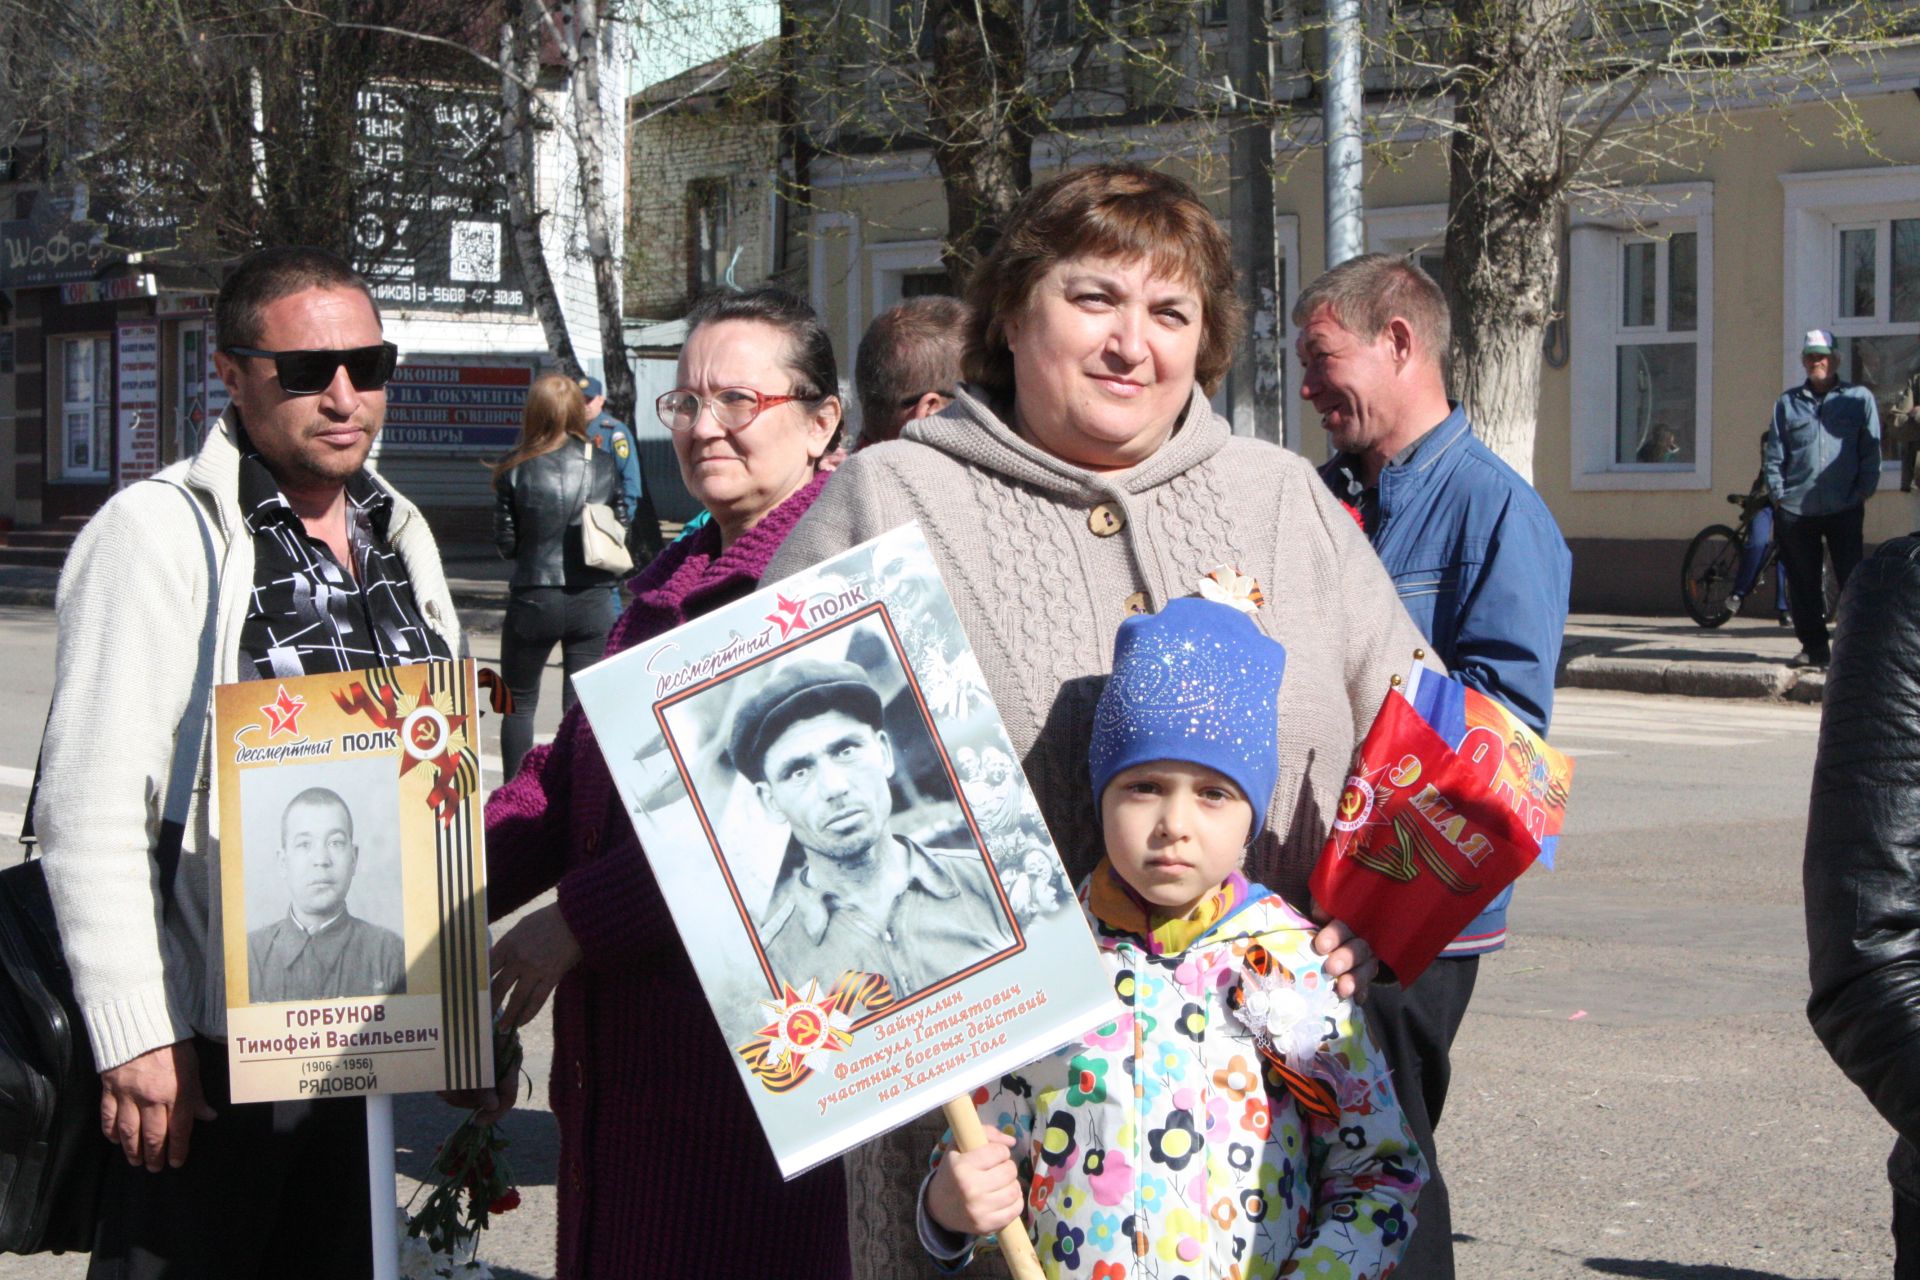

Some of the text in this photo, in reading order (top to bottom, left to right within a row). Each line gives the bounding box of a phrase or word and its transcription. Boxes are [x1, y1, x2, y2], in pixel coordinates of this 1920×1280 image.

[393, 367, 460, 382] ОКОПИЯ
[401, 388, 422, 402] НА
[428, 389, 528, 404] ДОКУМЕНТЫ
[386, 408, 448, 421] ОВЛЕНИЕ
[384, 428, 464, 443] ЦТОВАРЫ
[808, 586, 867, 623] ПОЛК
[342, 730, 397, 752] ПОЛК
[1389, 754, 1422, 787] 9
[1408, 783, 1494, 868] МАЯ
[285, 1004, 386, 1028] ГОРБУНОВ
[873, 990, 964, 1041] Зайнуллин
[236, 1027, 439, 1056] Тимофей Васильевич
[833, 983, 1023, 1081] Фаткулл Гатиятович
[817, 989, 1048, 1116] участник боевых действий
[301, 1059, 332, 1075] (1906
[342, 1057, 373, 1073] 1956)
[878, 1032, 1008, 1103] на Халхин-Голе
[298, 1071, 378, 1094] РЯДОВОЙ
